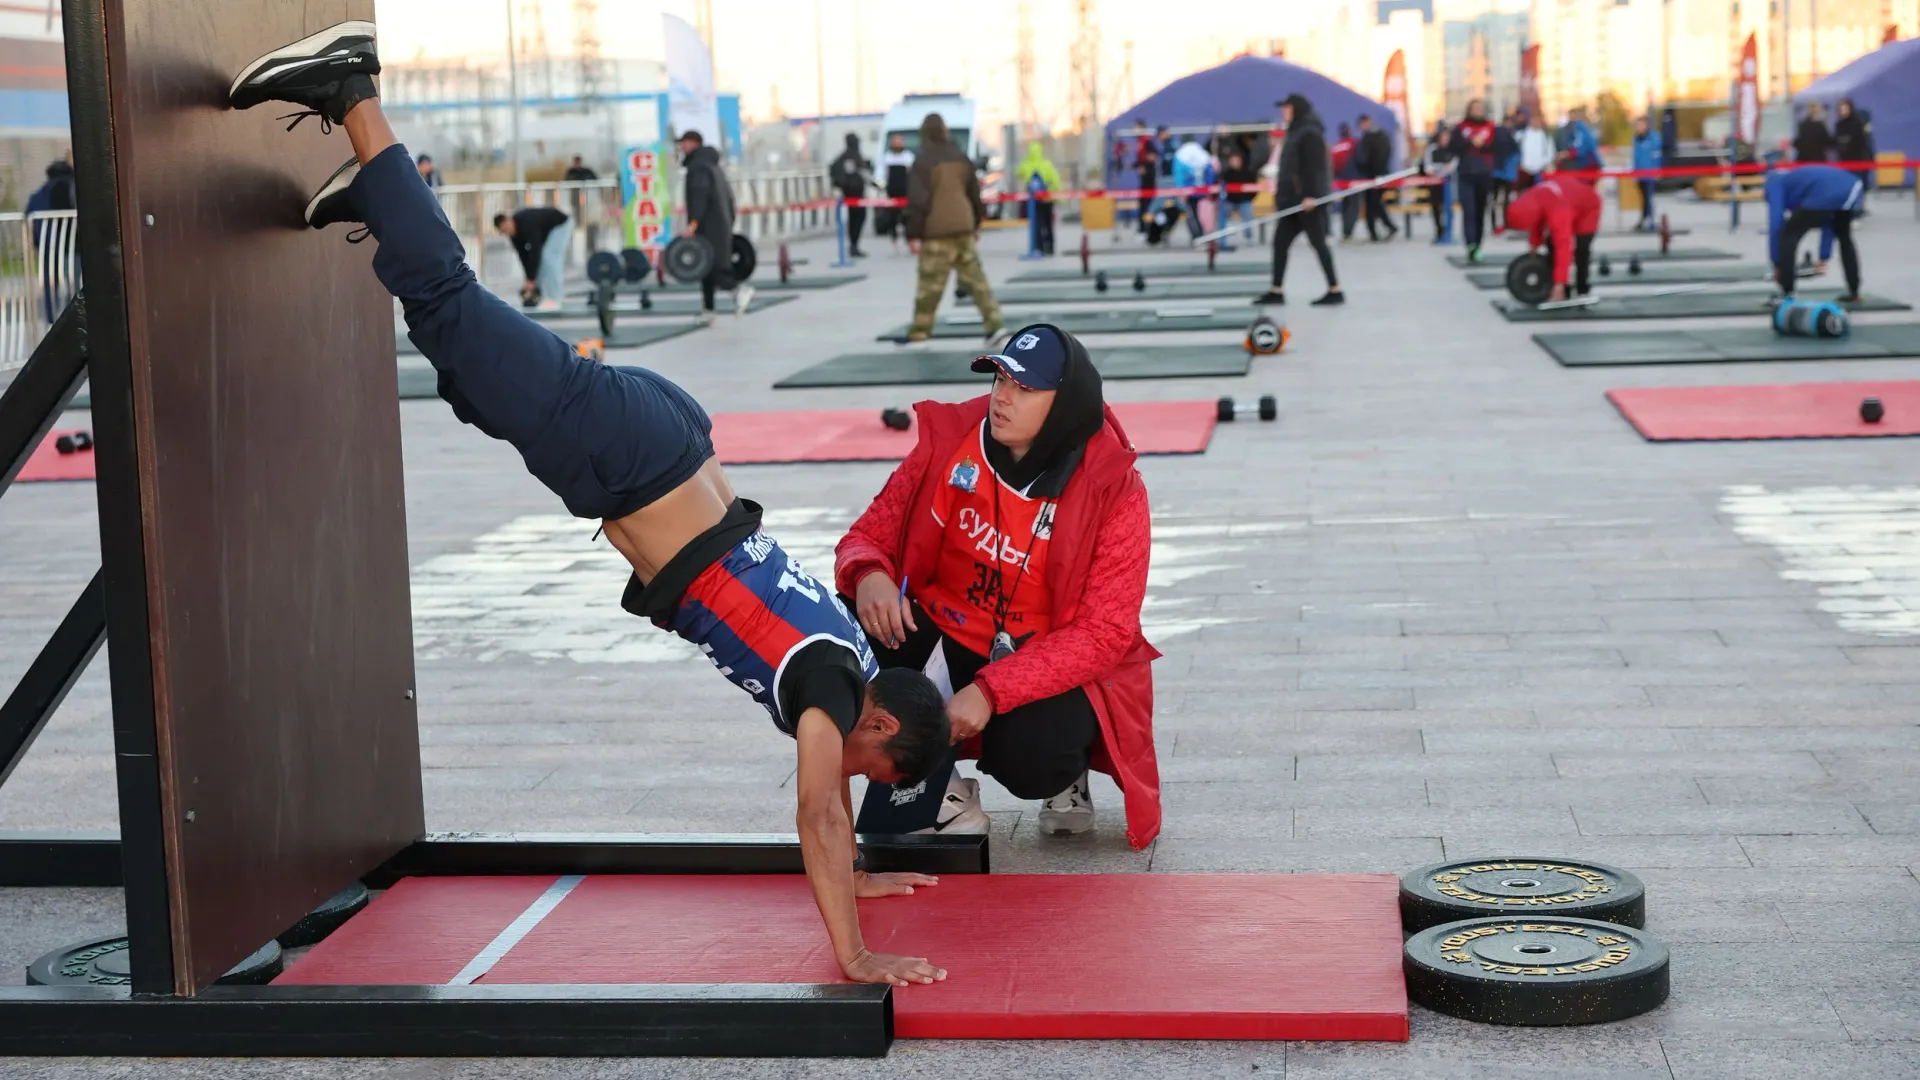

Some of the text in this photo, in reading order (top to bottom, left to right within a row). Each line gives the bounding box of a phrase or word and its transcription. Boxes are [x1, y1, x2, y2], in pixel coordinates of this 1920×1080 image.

[1450, 863, 1604, 884] YOUSTEEL
[1437, 884, 1596, 905] YOUSTEEL
[1440, 924, 1588, 952] YOUSTEEL
[64, 940, 129, 967] YOUS
[1479, 946, 1631, 975] YOUSTEEL
